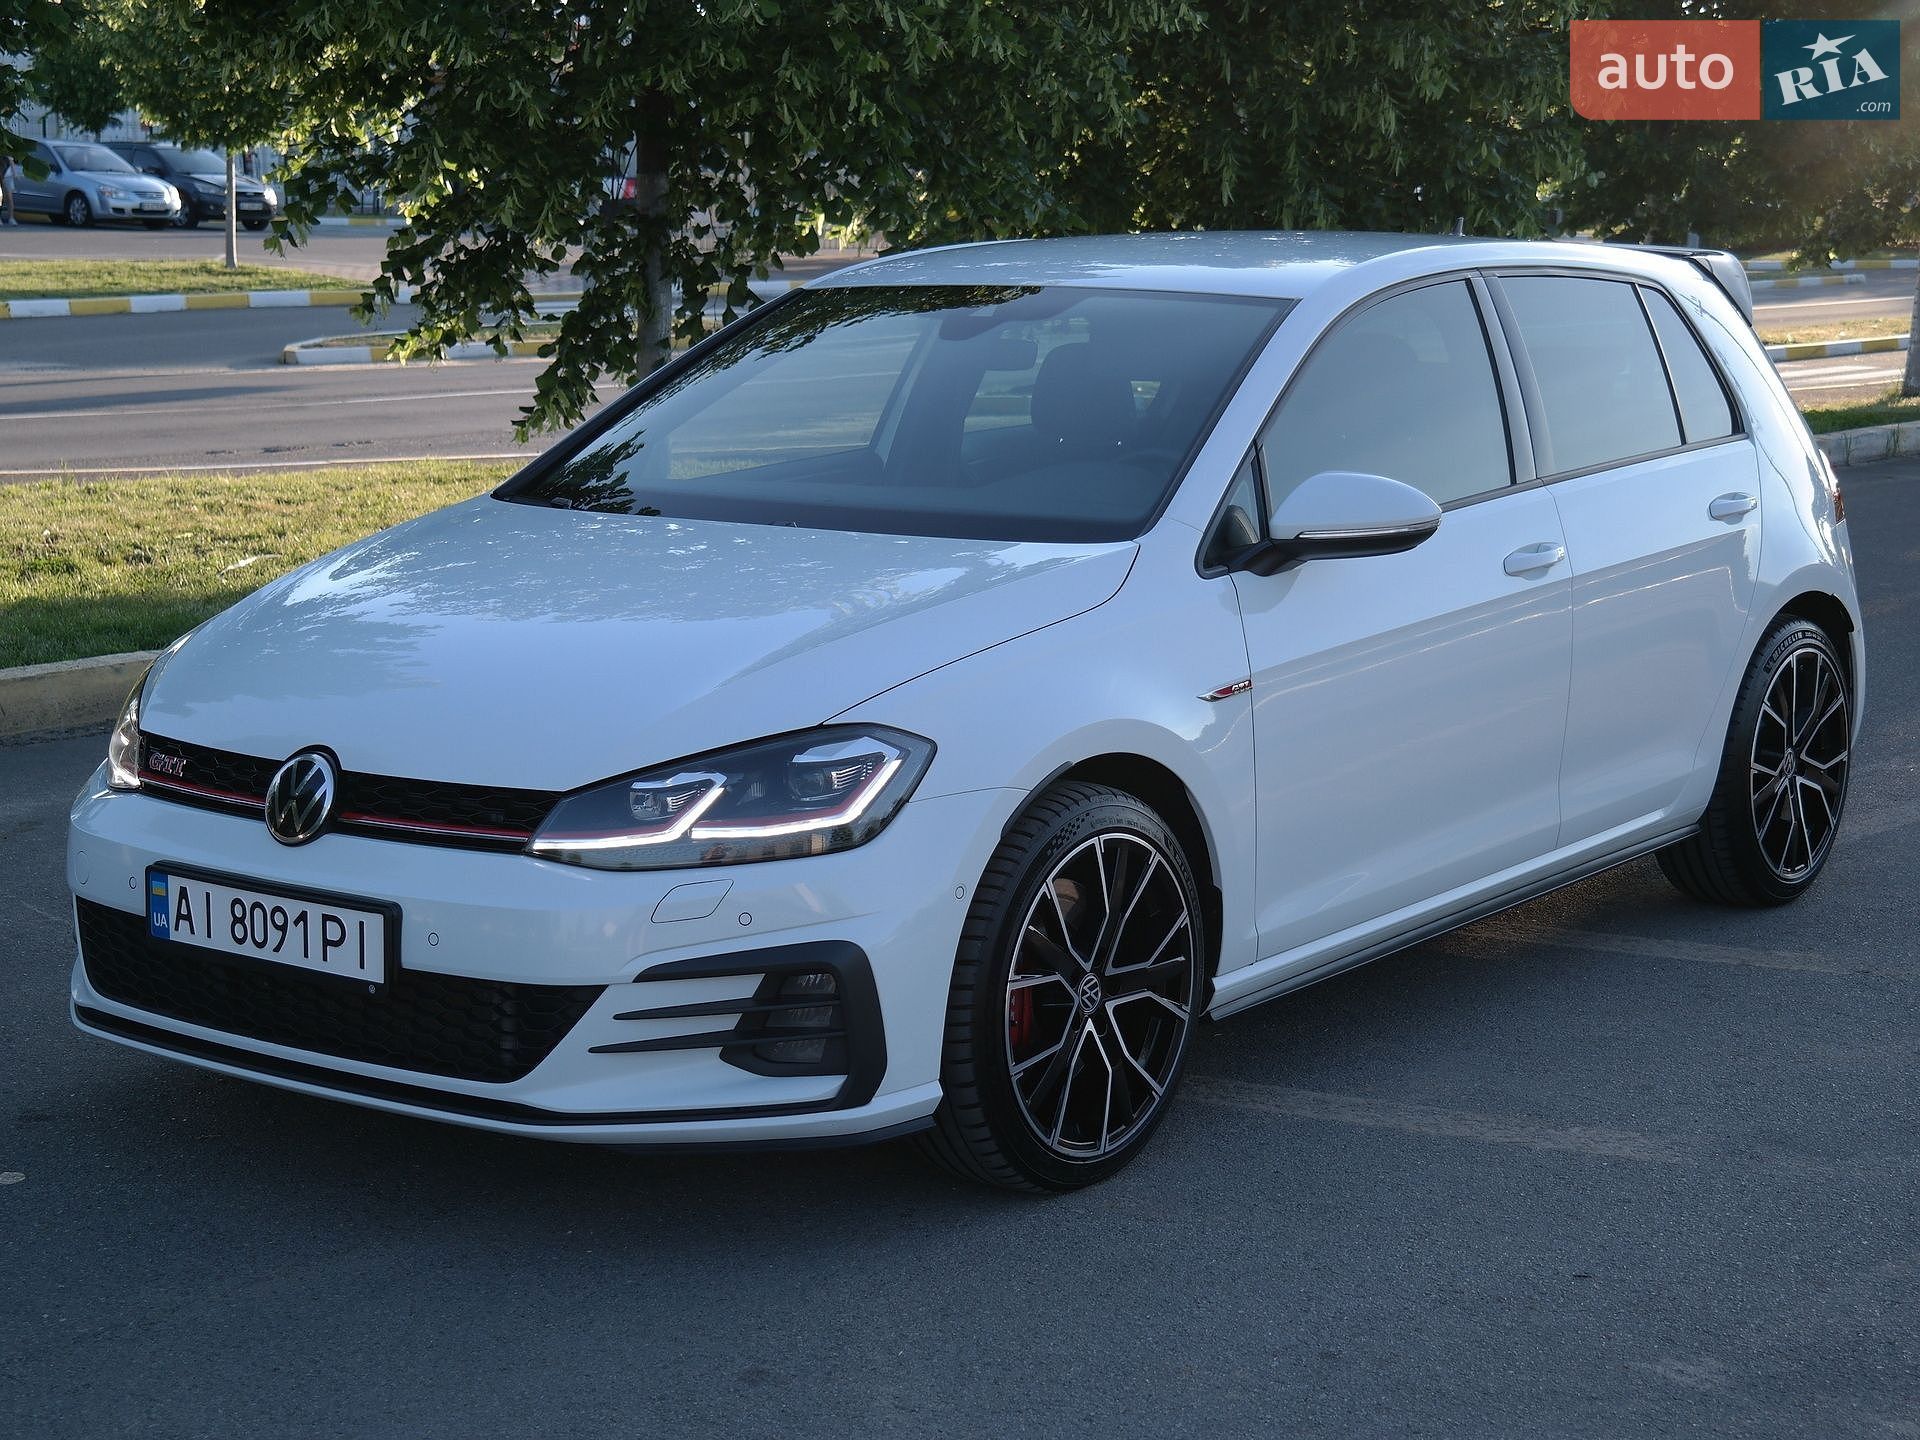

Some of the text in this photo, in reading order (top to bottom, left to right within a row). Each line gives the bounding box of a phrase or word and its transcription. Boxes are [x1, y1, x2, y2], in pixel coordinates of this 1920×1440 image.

[149, 751, 187, 777] GTI
[153, 911, 168, 928] UA
[174, 885, 366, 970] AI 8091 PI
